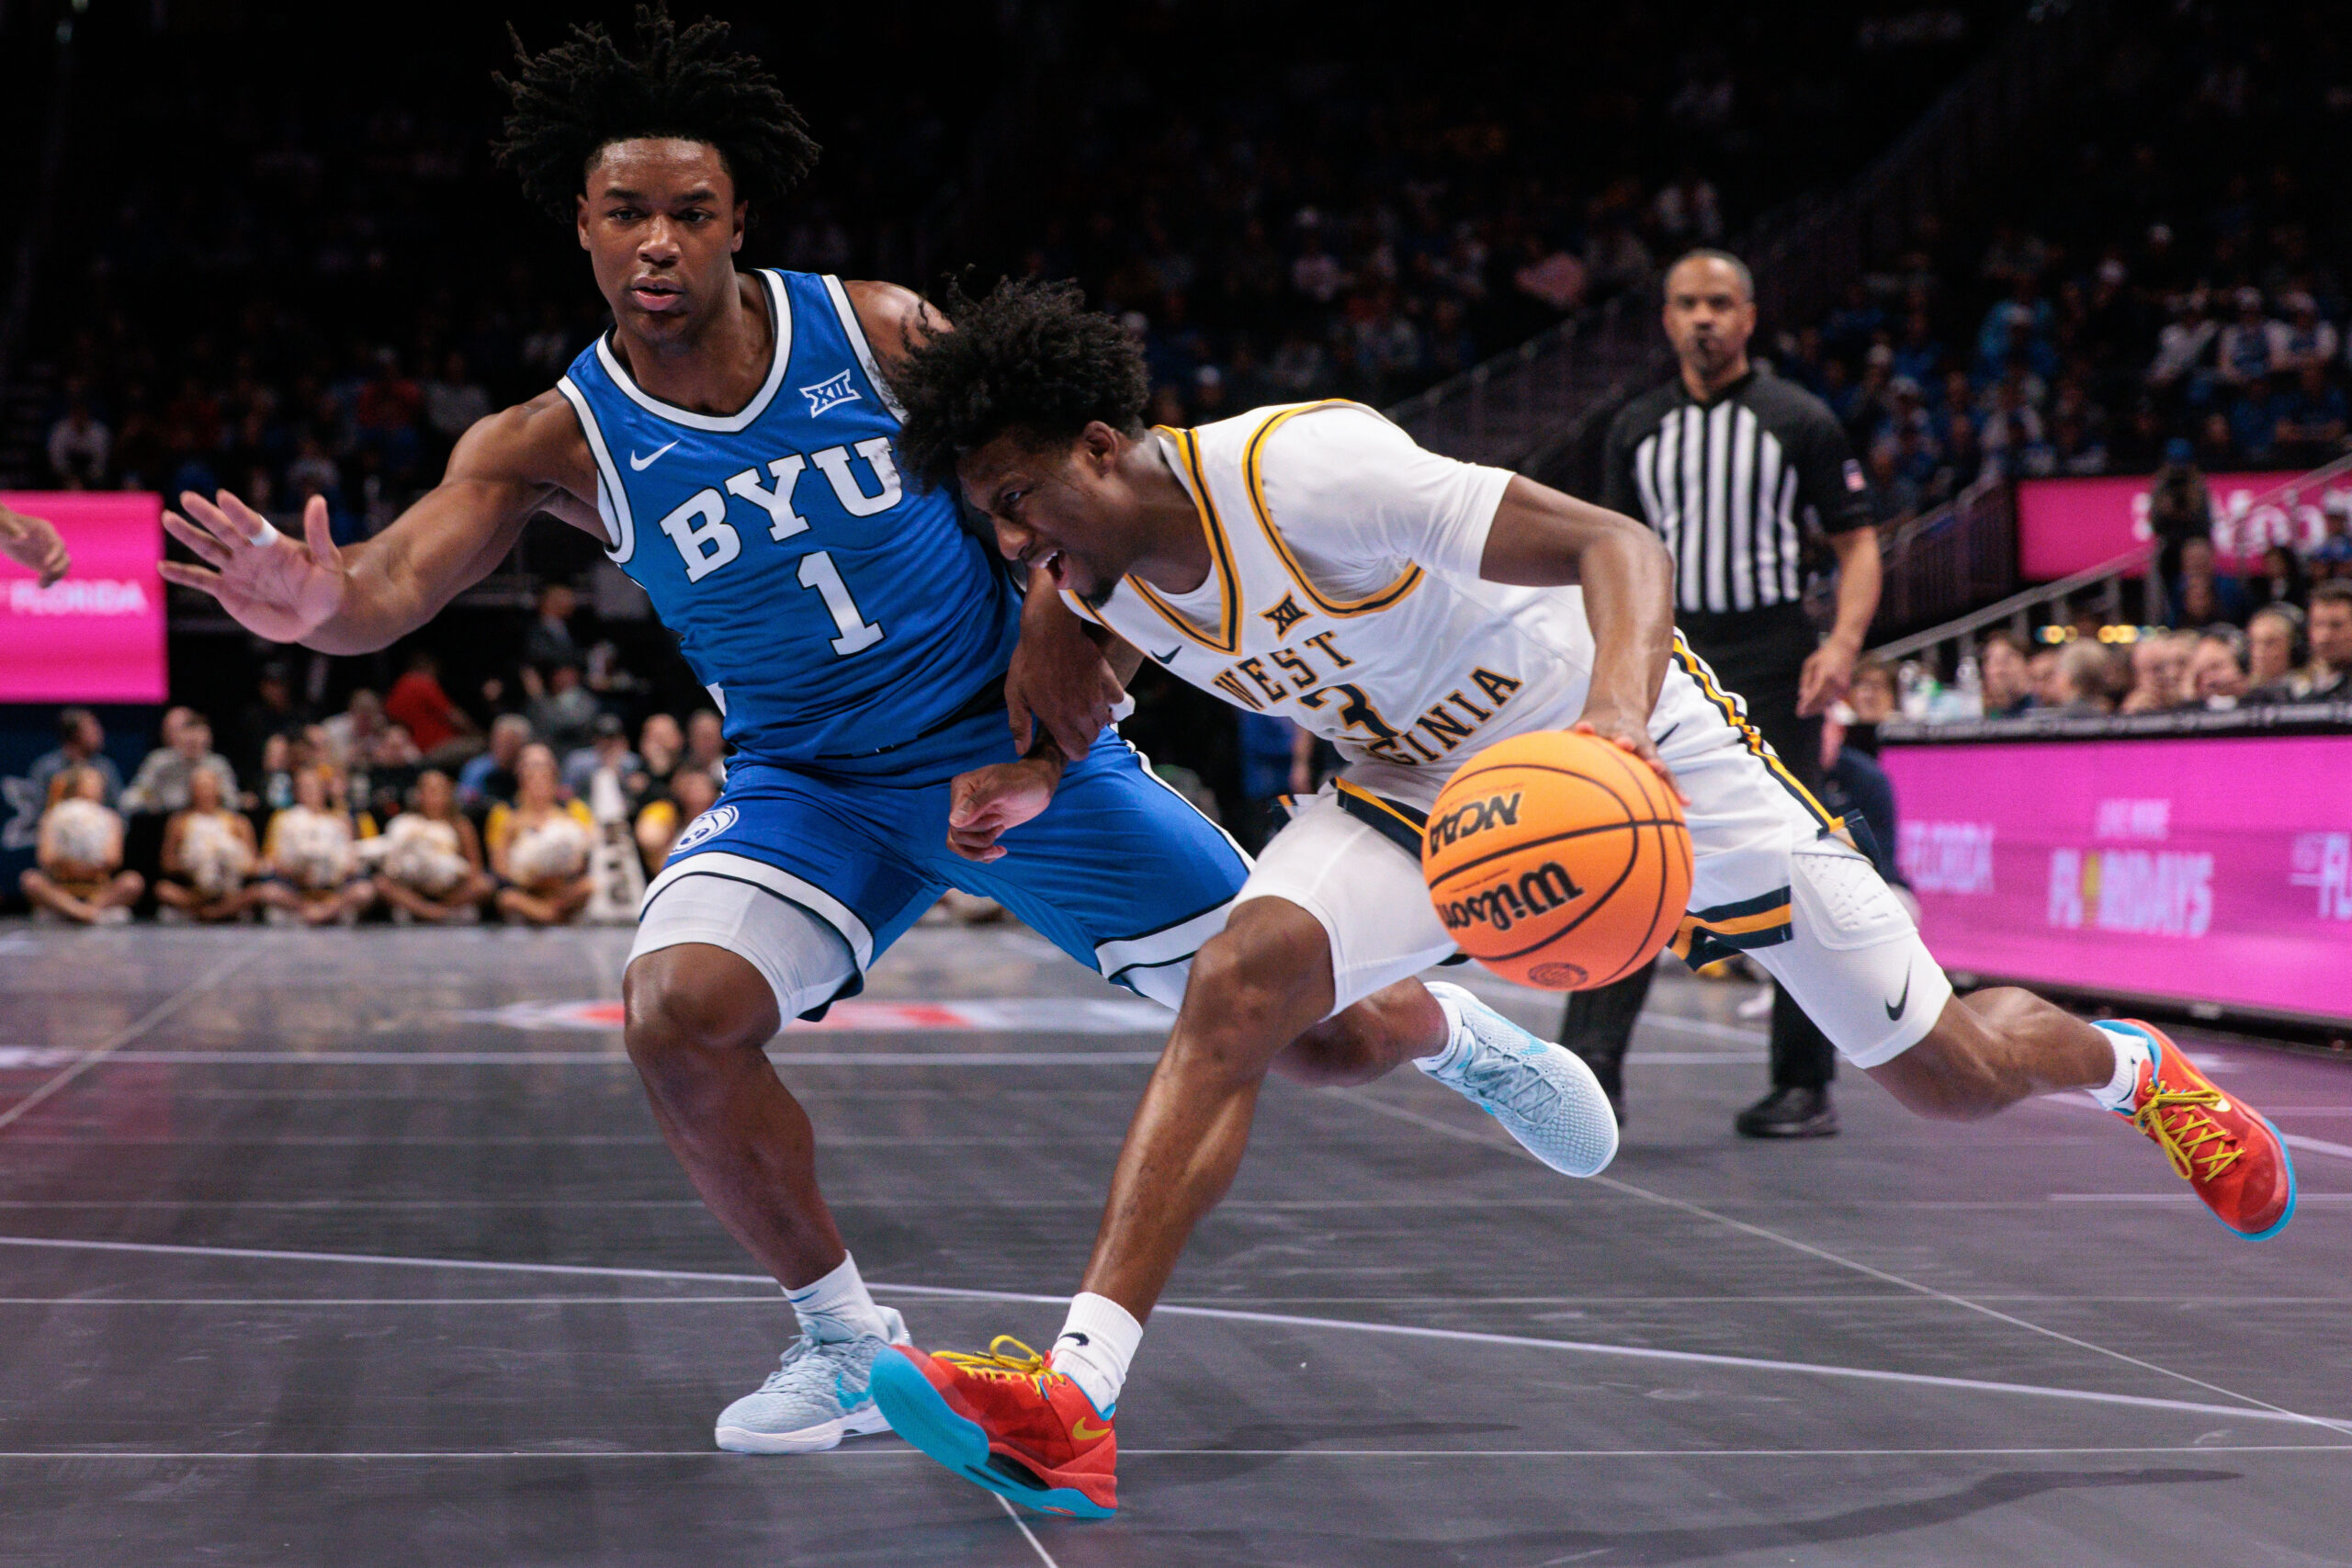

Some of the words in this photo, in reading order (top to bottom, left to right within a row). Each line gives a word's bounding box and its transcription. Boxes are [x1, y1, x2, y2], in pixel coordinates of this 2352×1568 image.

[660, 436, 903, 584] BYU
[797, 550, 886, 656] 1
[1212, 630, 1355, 711] WEST
[1365, 666, 1523, 766] GINIA
[1430, 793, 1521, 856] NCAA
[1437, 862, 1585, 931] Wilson
